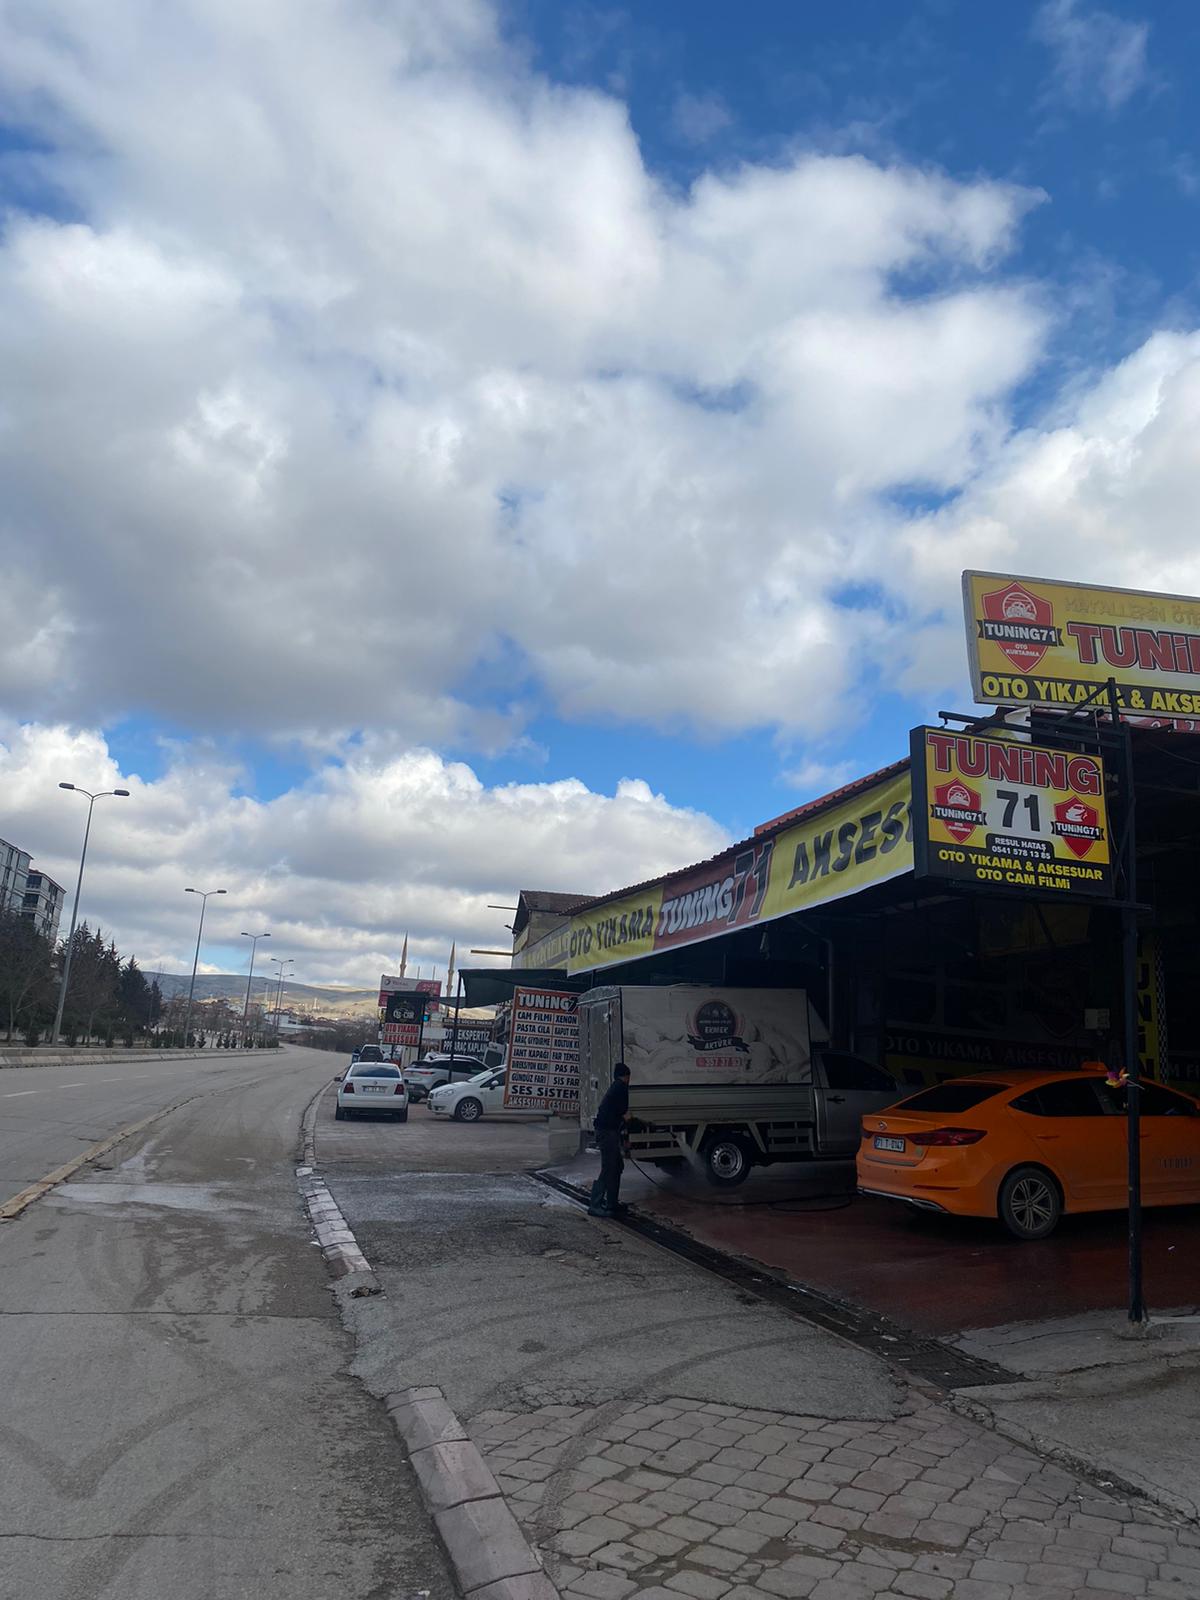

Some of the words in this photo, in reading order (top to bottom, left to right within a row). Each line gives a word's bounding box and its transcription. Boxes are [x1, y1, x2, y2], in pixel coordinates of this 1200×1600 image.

[982, 676, 1028, 699] OTO
[1131, 689, 1145, 709] &
[996, 789, 1040, 832] 71
[992, 845, 1012, 854] 0541
[1014, 848, 1028, 857] 578
[995, 837, 1020, 846] RESUL
[1022, 840, 1046, 852] HATAŞ
[938, 849, 965, 862] OTO
[968, 853, 1022, 870] YIKAMA
[1025, 861, 1034, 872] &
[1037, 862, 1103, 880] AKSESUAR
[976, 868, 1002, 882] OTO
[1006, 871, 1036, 886] CAM
[570, 926, 592, 958] OTO
[596, 905, 653, 951] YIKAMA
[518, 1012, 532, 1020] CAM
[555, 1015, 577, 1024] XENON
[516, 1024, 536, 1032] PASTA
[926, 1039, 993, 1061] YIKAMA
[555, 1064, 568, 1072] PAS
[511, 1084, 532, 1095] SES
